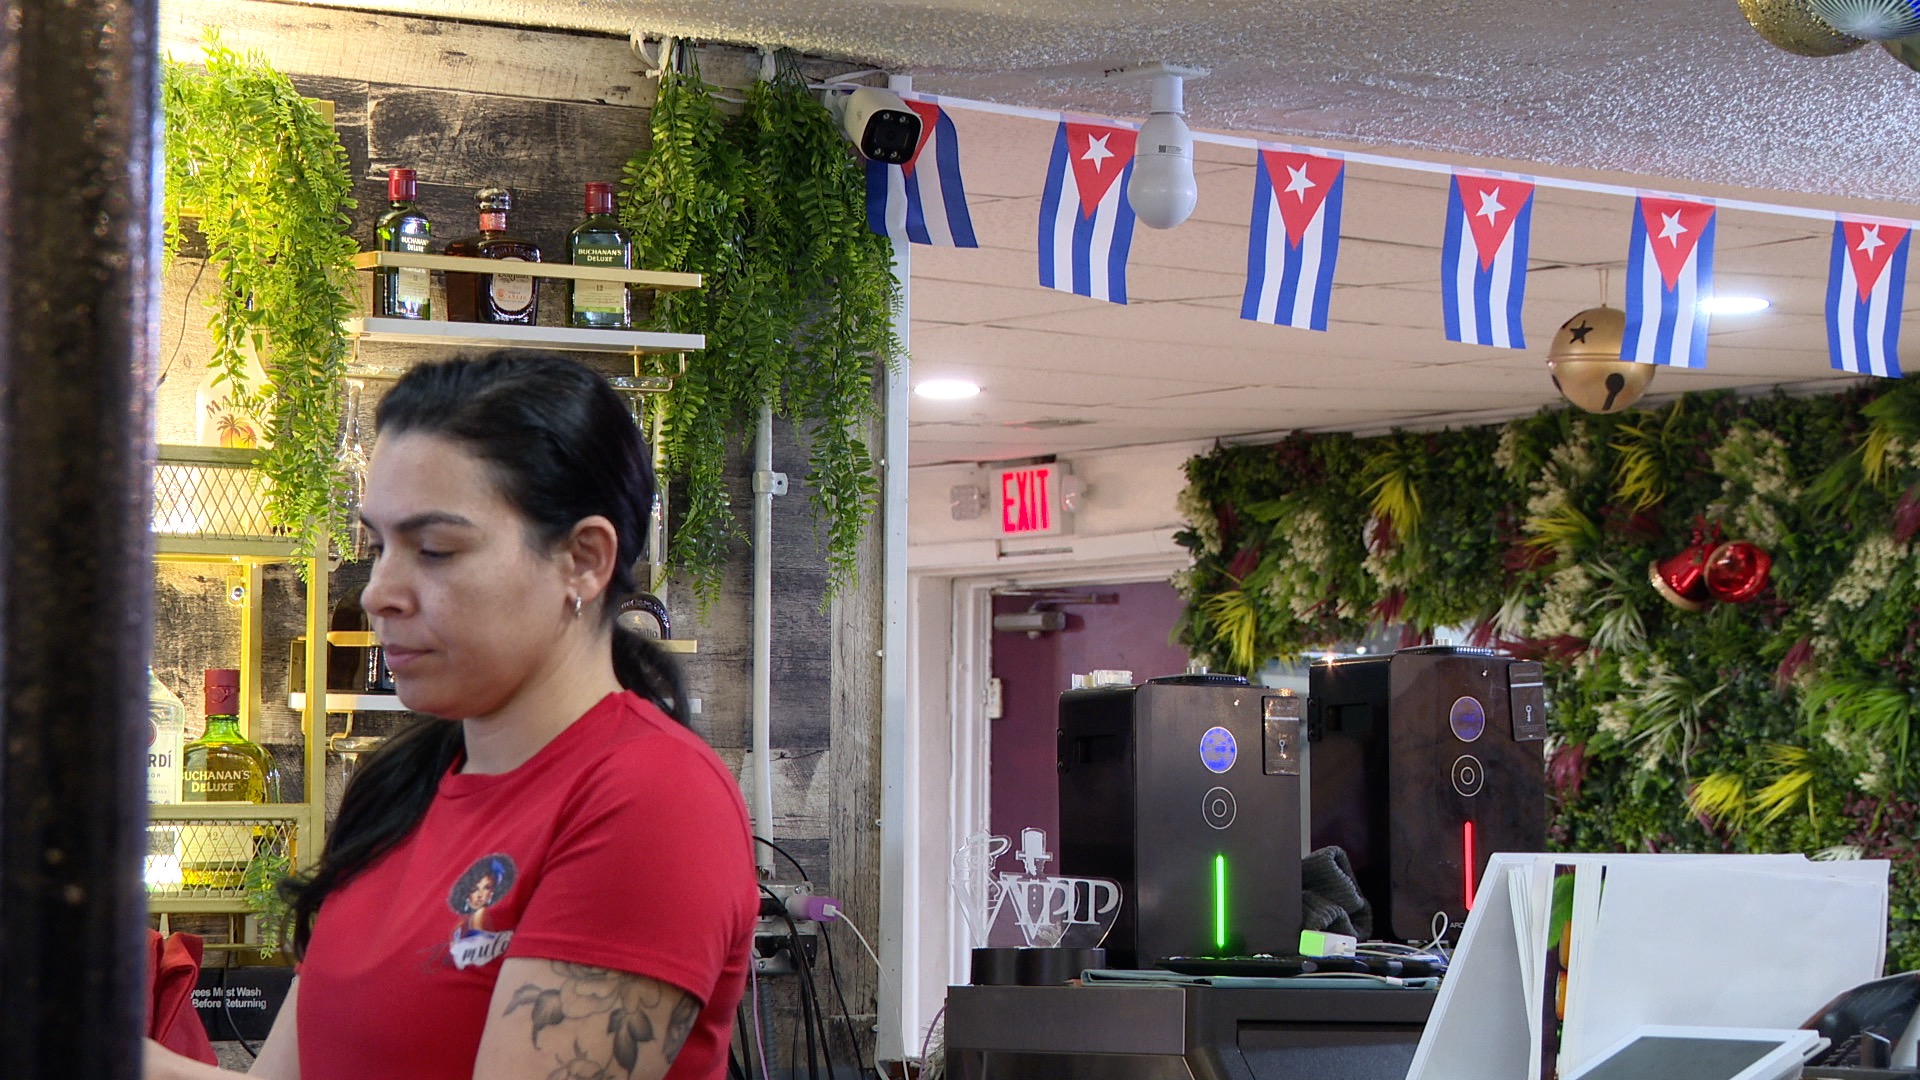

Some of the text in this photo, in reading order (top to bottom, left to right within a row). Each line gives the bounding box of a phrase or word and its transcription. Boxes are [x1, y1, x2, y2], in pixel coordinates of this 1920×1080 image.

[578, 248, 622, 256] BUCHANAN'S
[1003, 469, 1049, 532] EXIT
[181, 769, 251, 781] UCHANAN'S
[236, 987, 262, 997] Wash
[192, 998, 267, 1010] Before Returning
